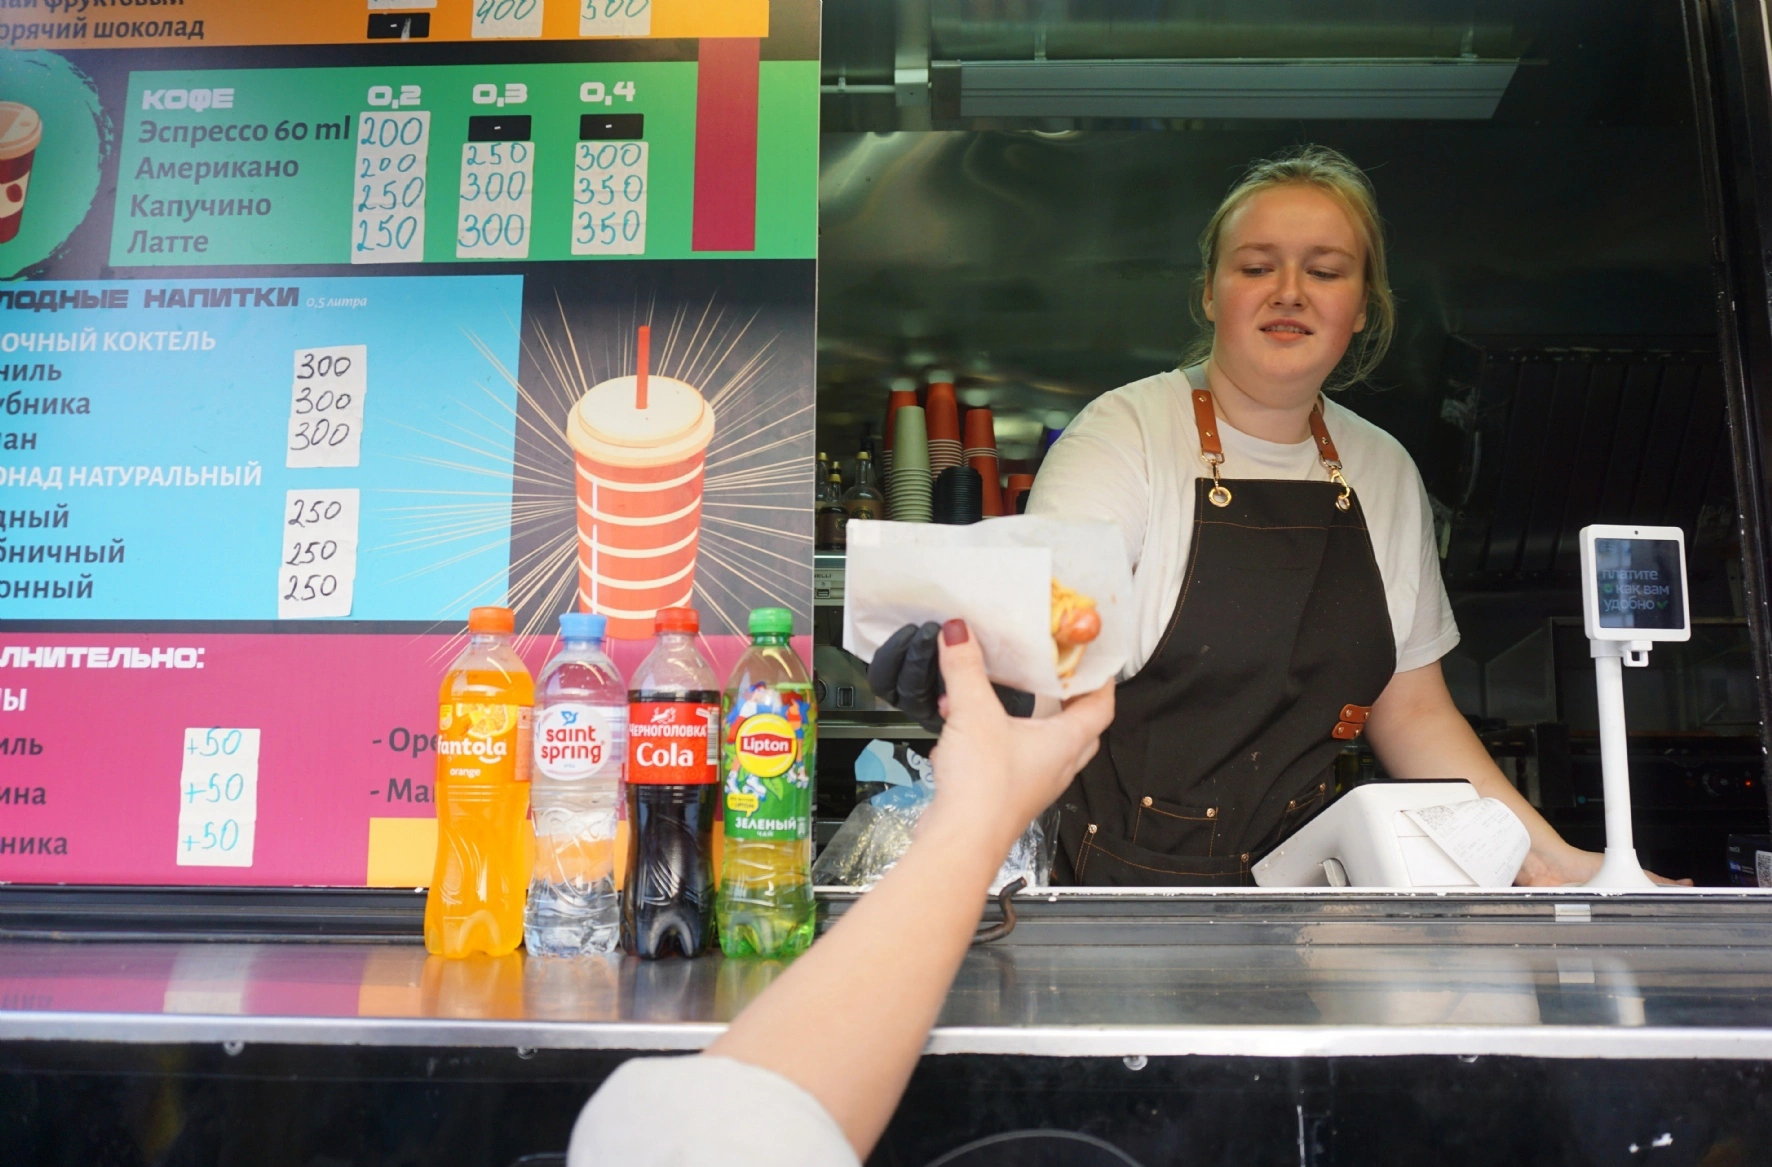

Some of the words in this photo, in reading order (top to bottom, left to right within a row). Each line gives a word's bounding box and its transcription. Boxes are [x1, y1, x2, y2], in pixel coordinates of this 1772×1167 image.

[93, 20, 205, 40] шоколад
[142, 88, 235, 112] КОФЕ
[367, 85, 421, 109] 0,2
[472, 83, 528, 107] 0,3
[579, 81, 636, 106] 0,4
[138, 120, 269, 147] Эспрессо
[274, 121, 308, 141] 60
[315, 115, 350, 140] ml
[360, 116, 423, 147] 200
[360, 154, 416, 178] 200
[467, 142, 527, 165] 250
[576, 143, 641, 171] 300
[135, 156, 299, 185] Американо
[358, 176, 424, 212] 250
[460, 171, 526, 201] 300
[574, 174, 643, 205] 350
[130, 193, 271, 222] Капучино
[356, 216, 418, 251] 250
[458, 213, 524, 248] 300
[576, 209, 640, 245] 350
[127, 230, 209, 254] Латте
[143, 287, 299, 308] НАПИТКИ
[306, 297, 325, 309] 0,5
[327, 296, 367, 309] литра
[103, 331, 216, 352] КОКТЕЛЬ
[296, 353, 351, 380] 300
[0, 390, 91, 415] бника
[295, 387, 351, 415] 300
[290, 418, 349, 450] 300
[69, 461, 262, 487] НАТУРАЛЬНЫЙ
[287, 499, 342, 528] 250
[285, 540, 337, 566] 250
[1602, 569, 1658, 580] платите
[283, 574, 337, 601] 250
[1616, 584, 1640, 594] как
[1643, 584, 1670, 595] вам
[1603, 595, 1655, 611] удобно
[186, 726, 243, 757] +50
[546, 725, 596, 742] saint
[629, 724, 706, 737] ЧЕРНОГОЛОВКА
[541, 744, 601, 764] spring
[636, 742, 693, 767] Cola
[743, 737, 789, 753] Lipton
[450, 768, 481, 779] orange
[184, 773, 244, 804] +50
[182, 820, 239, 852] +50
[735, 817, 797, 831] ЗЕЛЕНЫЙ
